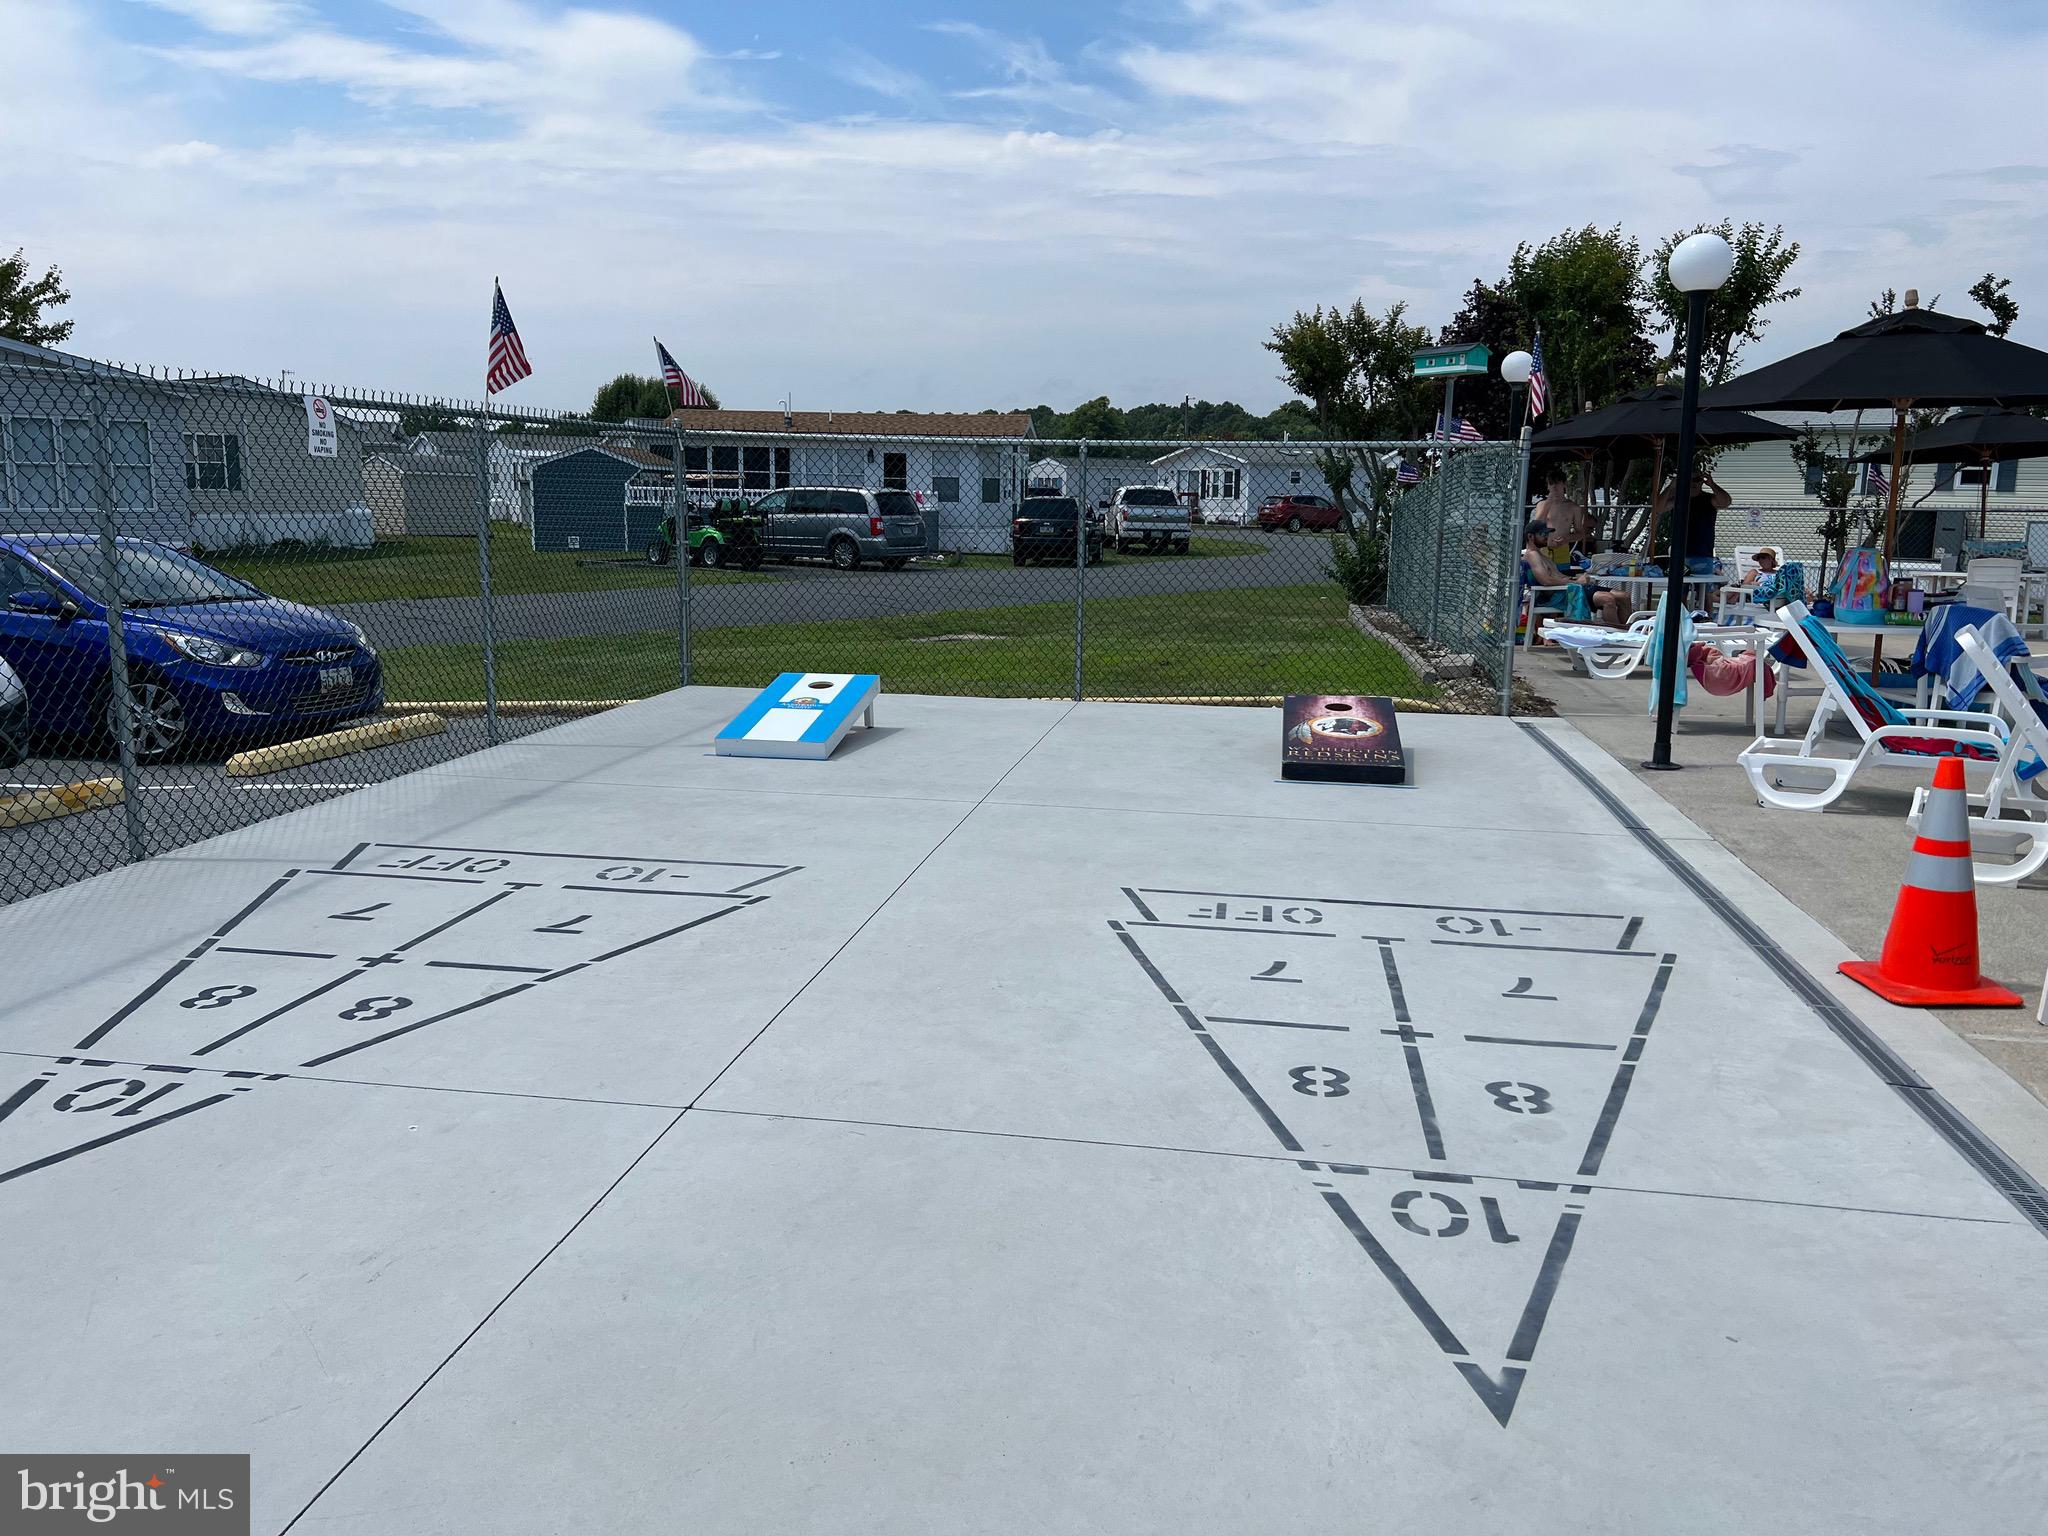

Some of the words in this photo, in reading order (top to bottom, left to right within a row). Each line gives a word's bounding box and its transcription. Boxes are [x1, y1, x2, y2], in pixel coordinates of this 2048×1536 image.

[312, 429, 334, 438] SMOKING
[314, 446, 333, 454] VAPING
[1287, 750, 1401, 760] REDSKINS
[1288, 746, 1398, 754] WASHINGTON
[377, 854, 511, 873] OFF
[1188, 902, 1323, 924] OFF
[179, 985, 258, 1009] 8
[338, 996, 413, 1021] 8
[1288, 1065, 1351, 1097] 8
[53, 1078, 184, 1117] 10
[1485, 1080, 1554, 1115] 8
[1391, 1190, 1520, 1244] 10
